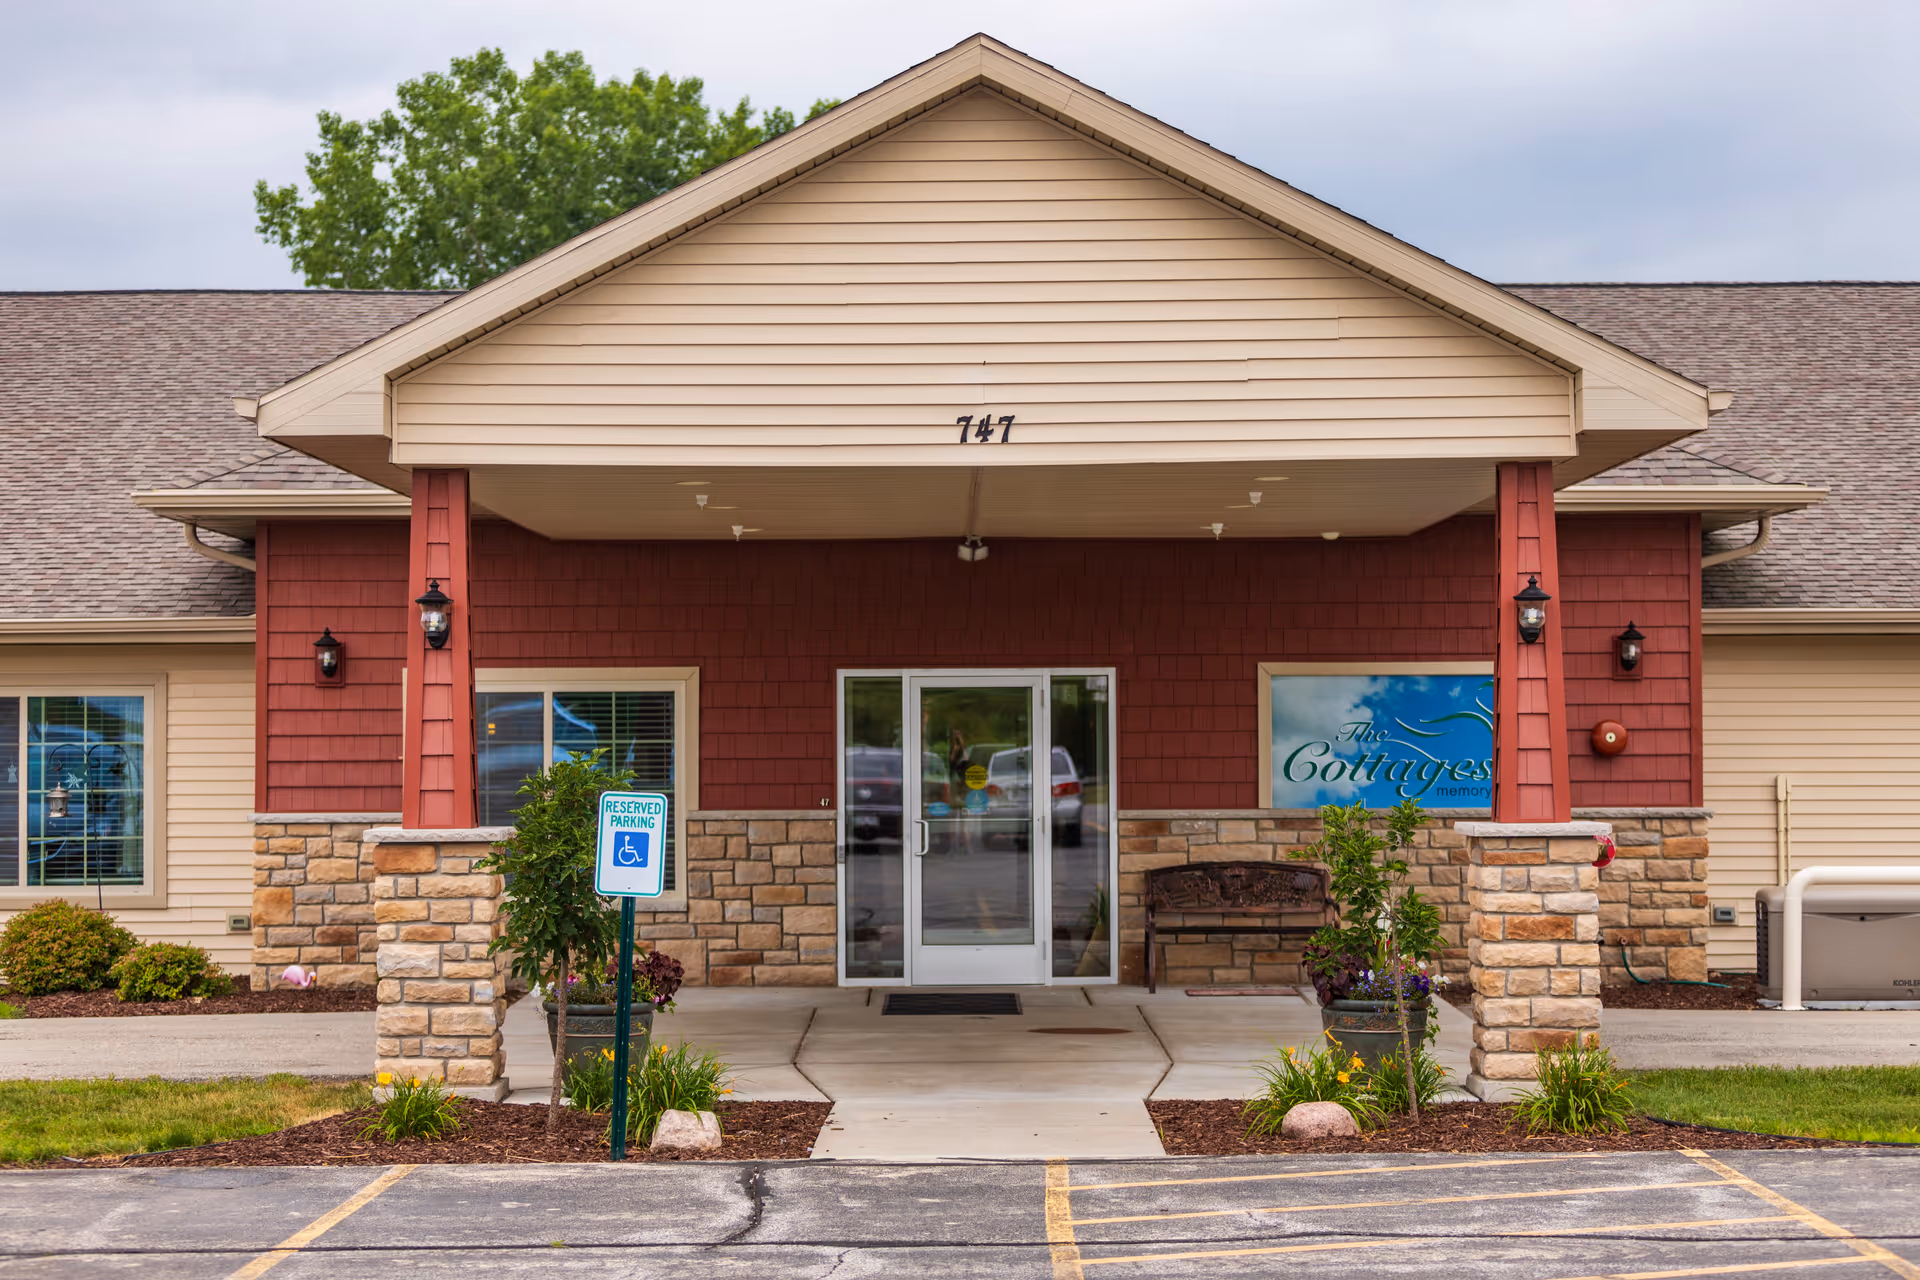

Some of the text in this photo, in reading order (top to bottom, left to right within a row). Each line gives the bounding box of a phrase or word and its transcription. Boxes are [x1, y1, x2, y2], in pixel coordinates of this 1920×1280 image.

[956, 414, 1015, 444] 747
[1336, 721, 1391, 742] The
[1283, 740, 1492, 798] Cottages
[1436, 786, 1492, 799] memory
[606, 801, 661, 814] RESERVED
[610, 815, 655, 829] PARKING
